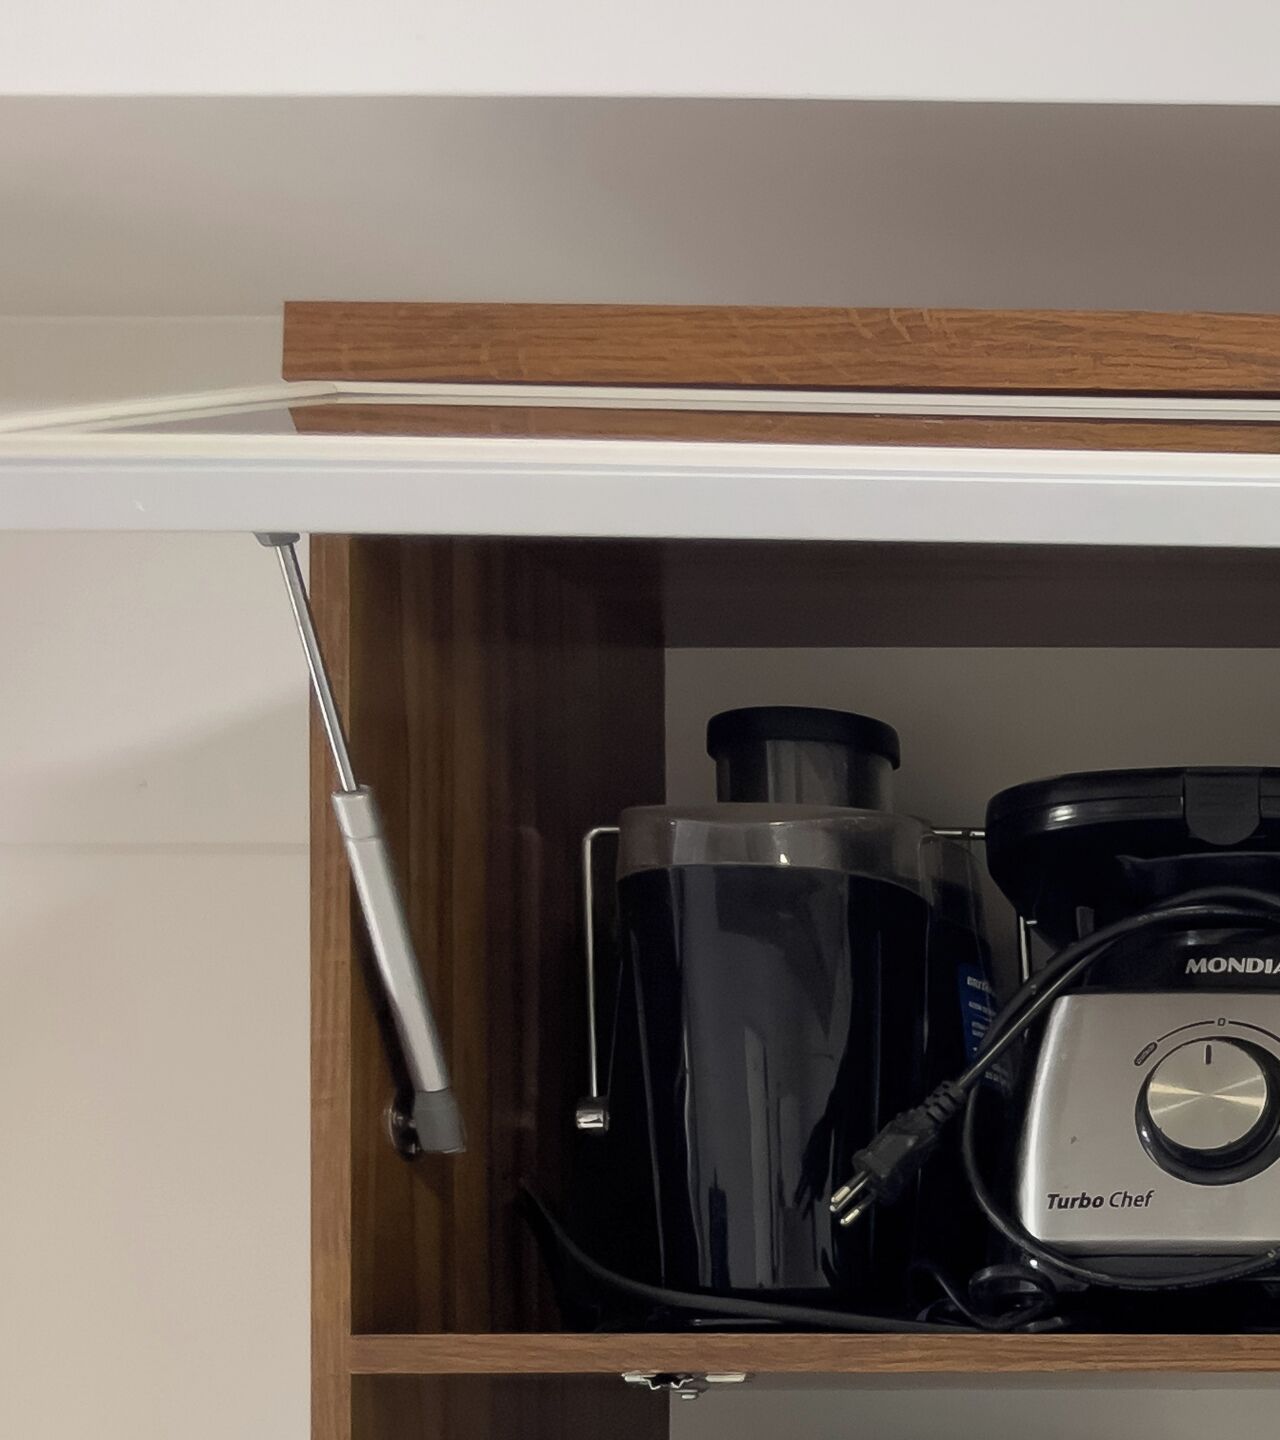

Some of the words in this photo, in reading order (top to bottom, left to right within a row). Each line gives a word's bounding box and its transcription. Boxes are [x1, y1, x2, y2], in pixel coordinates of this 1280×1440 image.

[1217, 1018, 1226, 1026] 0
[1047, 1192, 1105, 1210] Turbo
[1109, 1189, 1155, 1208] Chef
